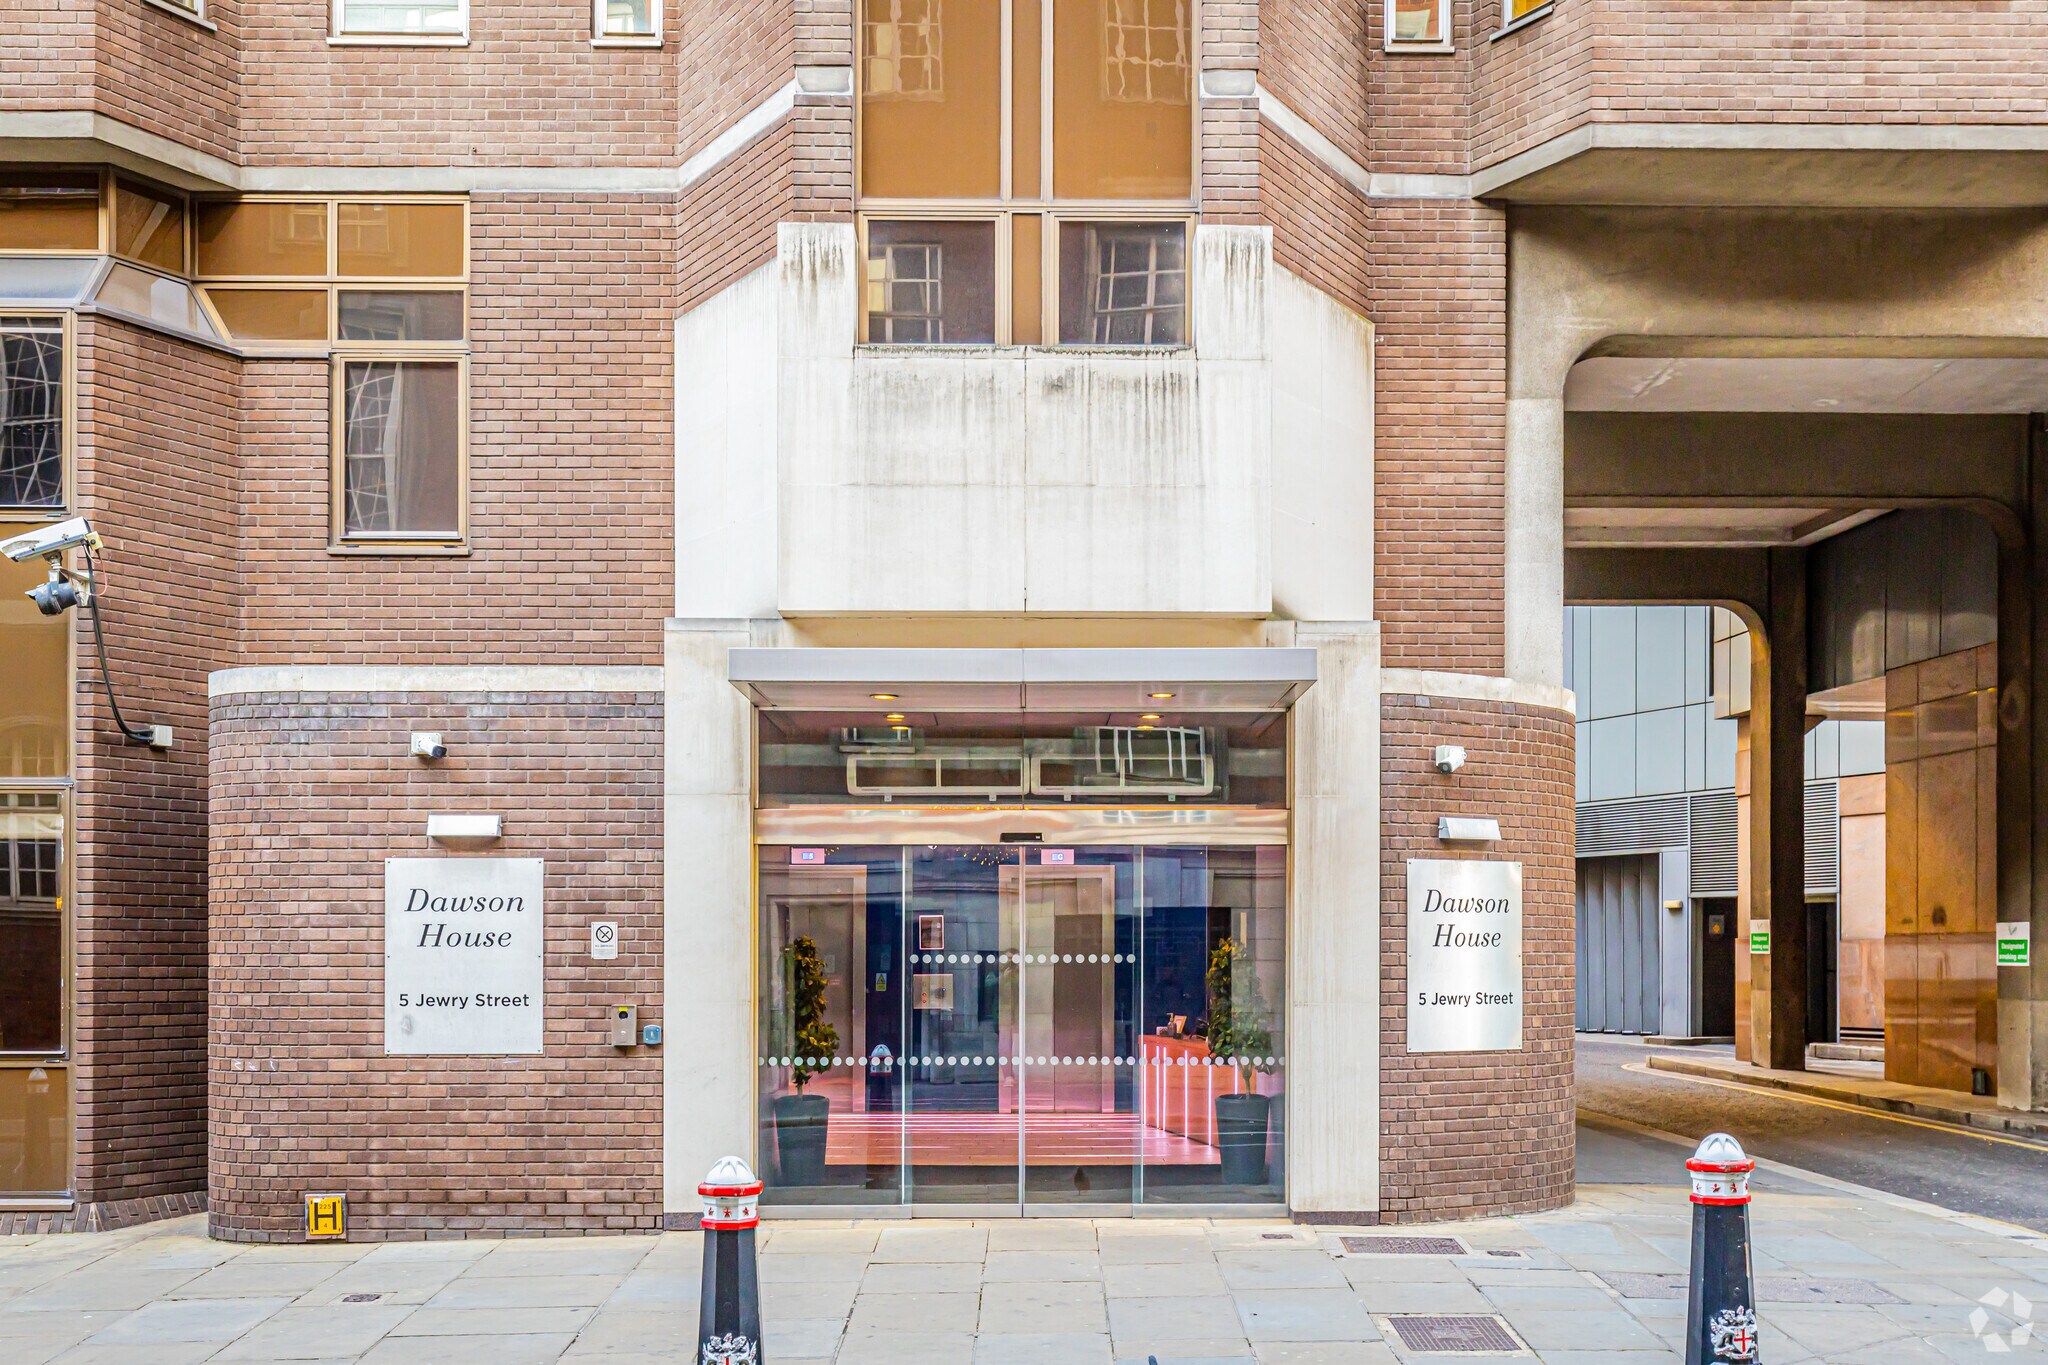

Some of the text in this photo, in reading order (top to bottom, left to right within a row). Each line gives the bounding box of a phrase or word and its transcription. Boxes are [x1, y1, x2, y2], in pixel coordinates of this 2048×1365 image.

[404, 888, 525, 913] Dawson
[1422, 889, 1510, 914] Dawson
[416, 923, 512, 948] House
[1432, 923, 1501, 948] House
[399, 993, 530, 1010] 5 Jewry Street
[1418, 991, 1514, 1008] 5 Jewry Street
[314, 1201, 337, 1231] H
